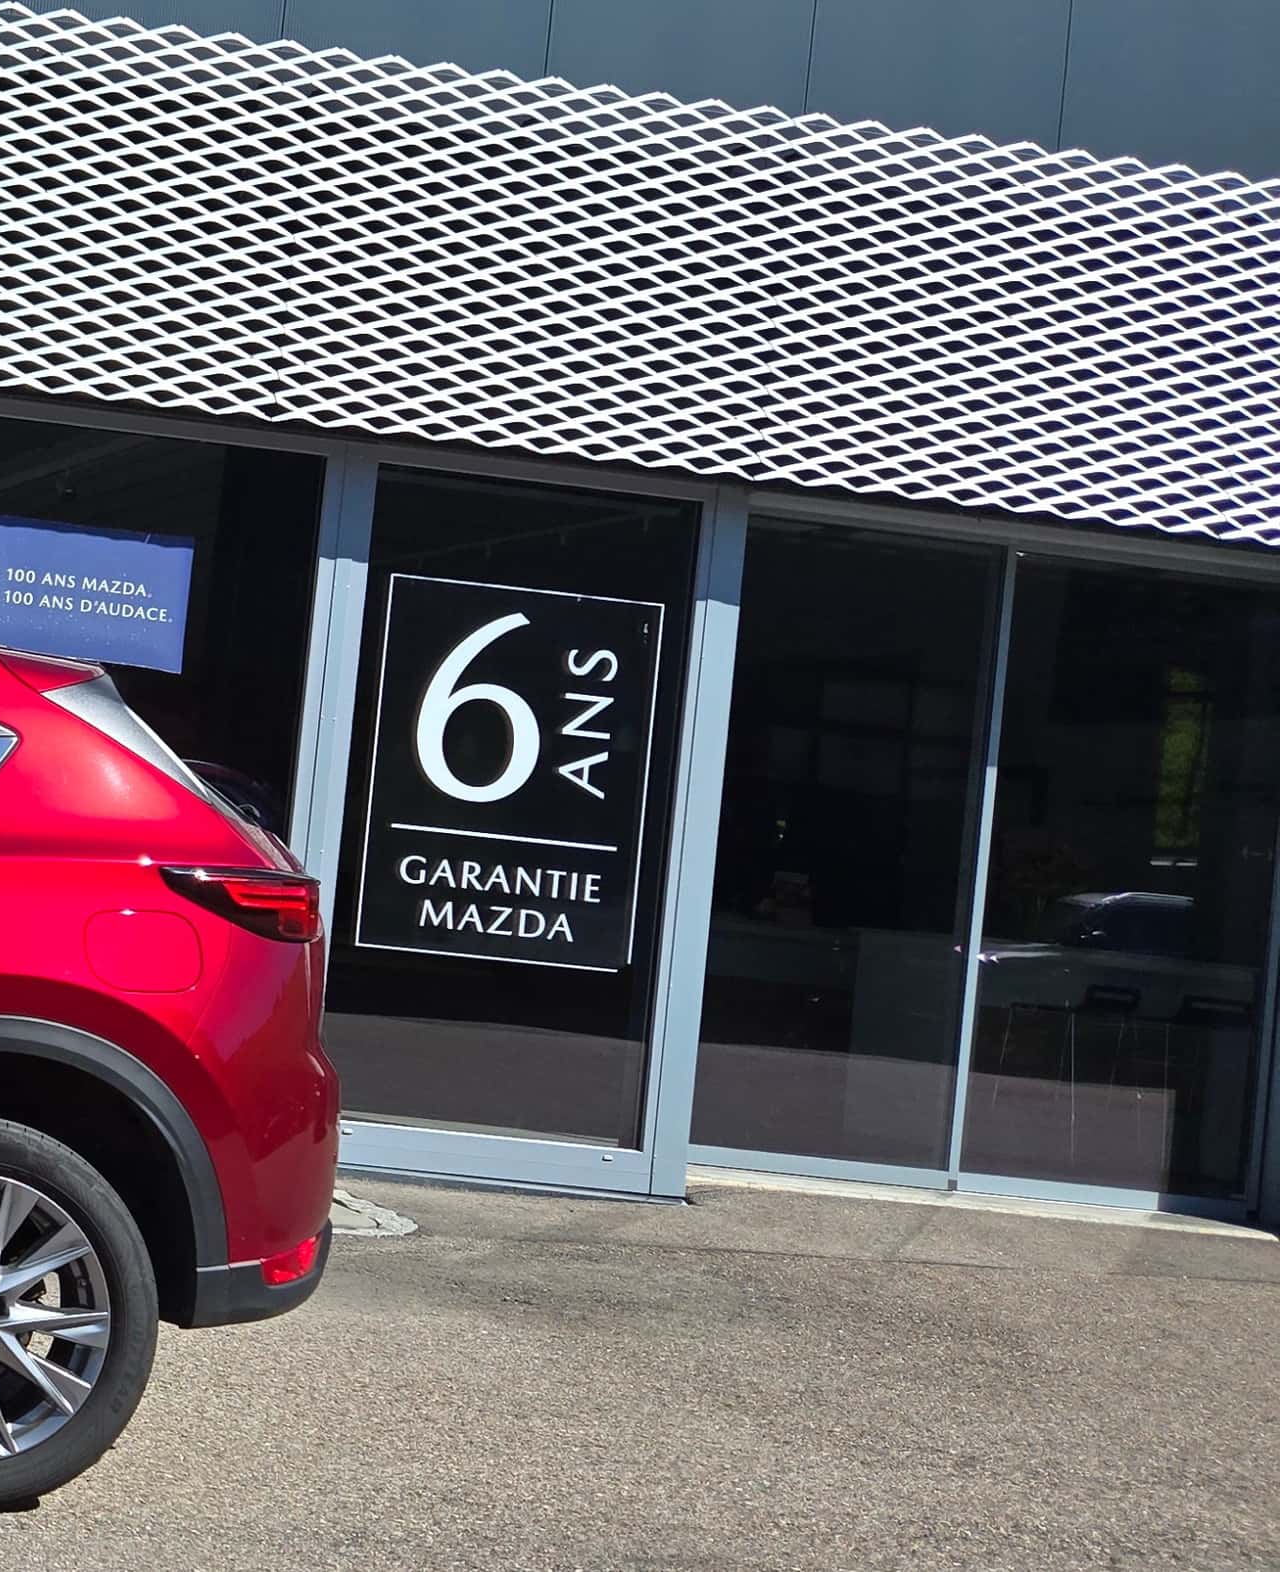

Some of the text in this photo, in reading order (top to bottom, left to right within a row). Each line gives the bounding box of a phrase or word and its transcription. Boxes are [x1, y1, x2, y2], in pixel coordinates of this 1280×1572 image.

[4, 589, 34, 605] 100
[39, 594, 74, 611] ANS
[6, 568, 152, 598] 100 ANS MAZDA.
[416, 612, 541, 803] 6
[558, 648, 619, 801] ANS
[399, 855, 601, 903] GARANTIE
[418, 899, 574, 942] MAZDA
